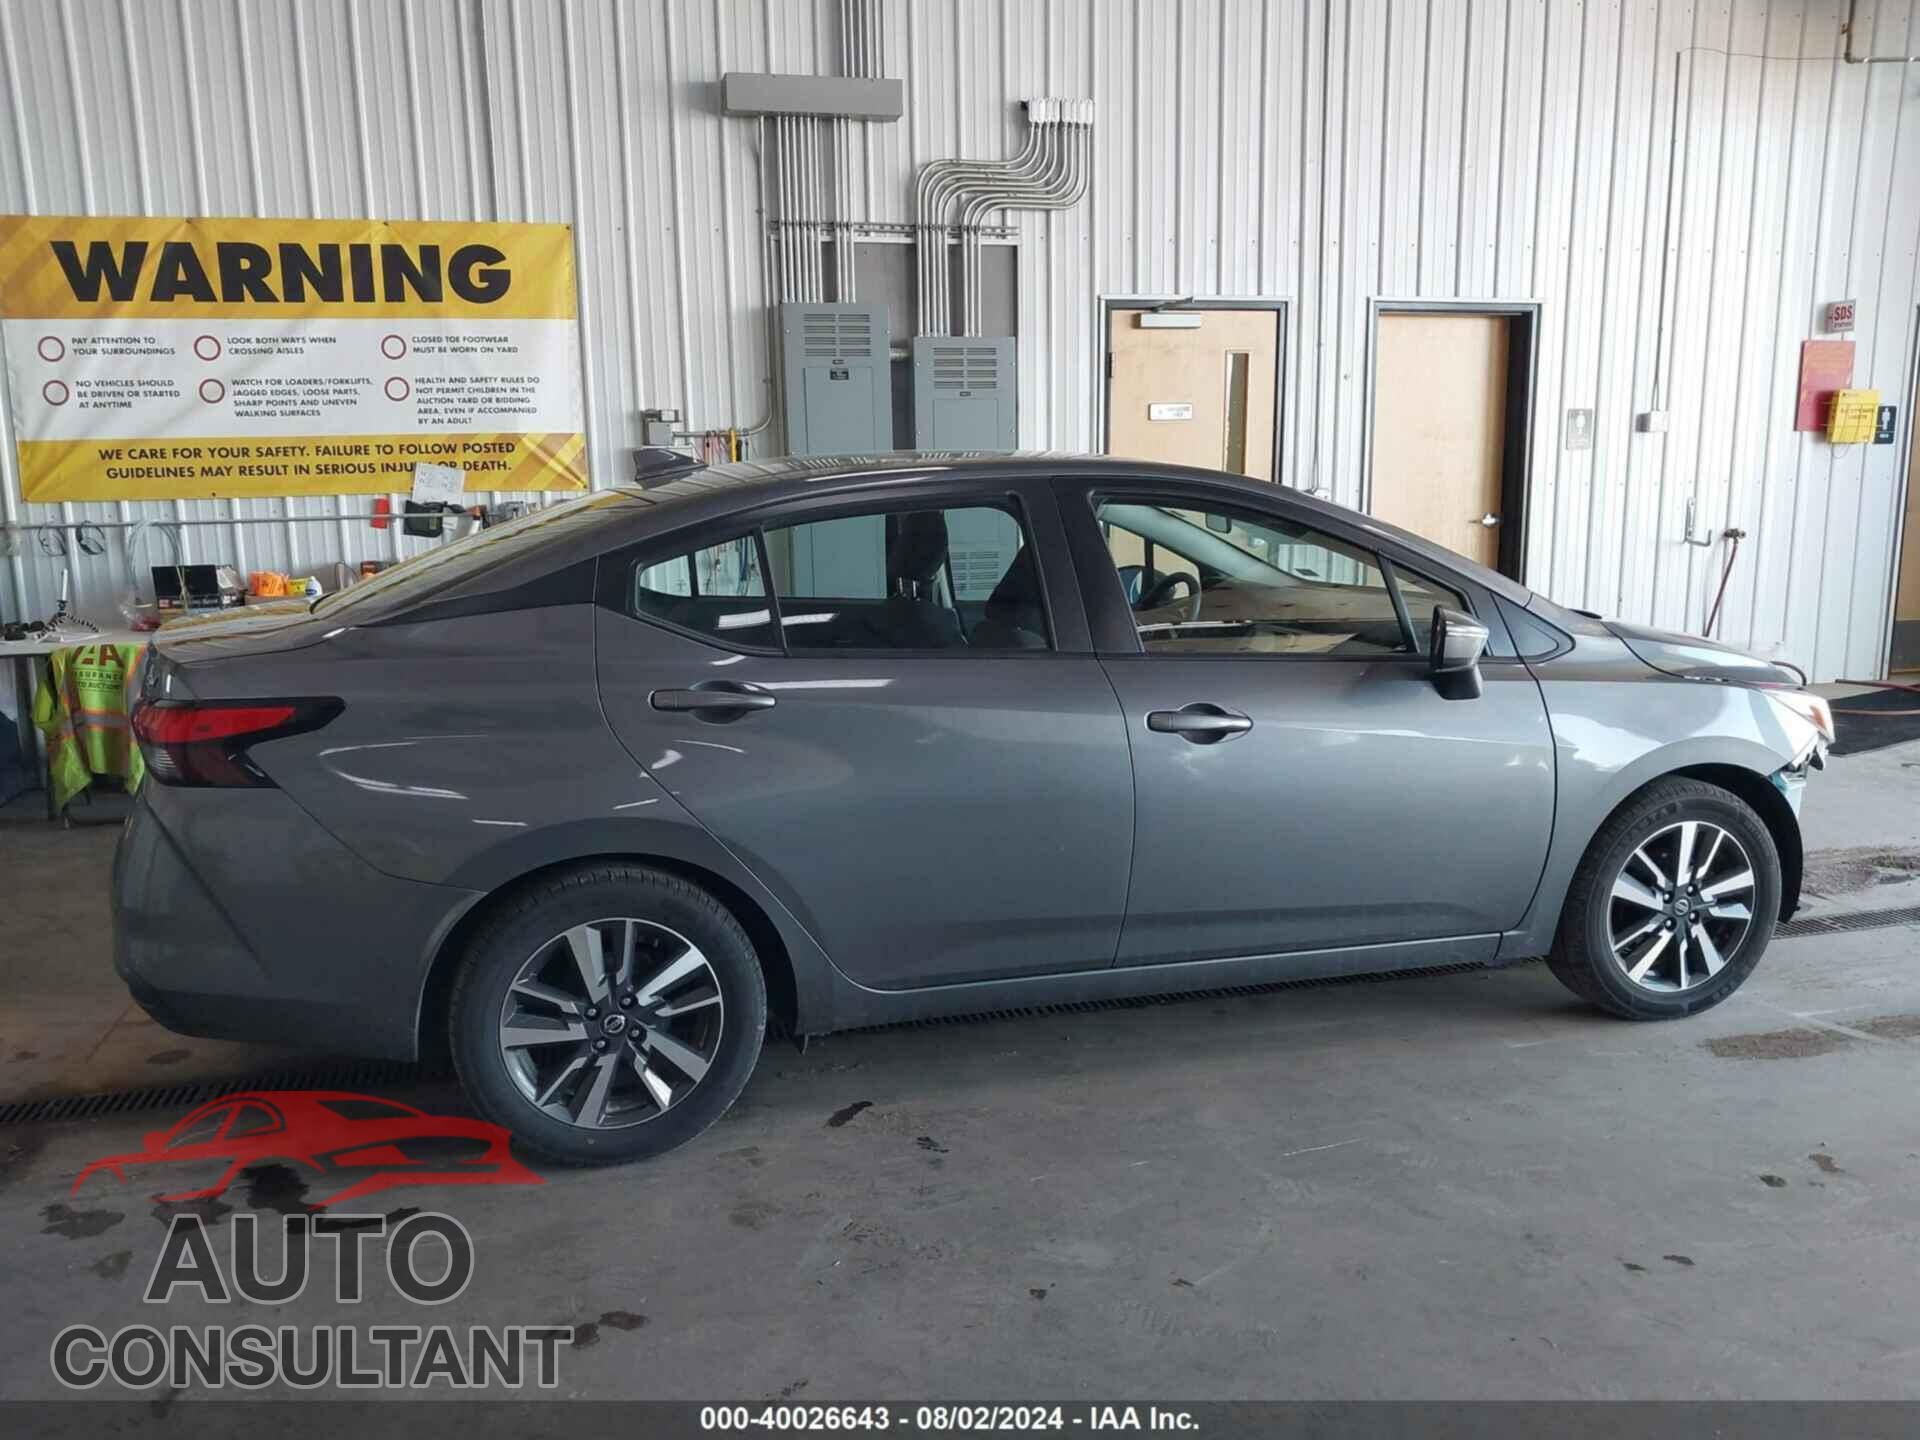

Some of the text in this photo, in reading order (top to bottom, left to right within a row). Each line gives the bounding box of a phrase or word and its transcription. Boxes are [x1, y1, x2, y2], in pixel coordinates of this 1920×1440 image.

[49, 240, 512, 304] WARNING
[1834, 305, 1853, 321] SDS
[227, 337, 251, 345] LOOK
[101, 347, 176, 355] SURROUNDINGS
[229, 347, 274, 355] CROSSING
[76, 380, 92, 388] NO
[91, 390, 125, 398] DRIVEN
[234, 399, 263, 407] SHARP
[99, 442, 515, 460] WE CARE FOR YOUR SAFETY. FAILURE TO FOLLOW POSTED
[106, 466, 195, 479] GUIDELINES
[200, 465, 233, 477] MAY
[239, 464, 289, 476] RESULT
[294, 464, 310, 475] IN
[316, 463, 376, 474] SERIOUS
[463, 459, 512, 471] DEATH.
